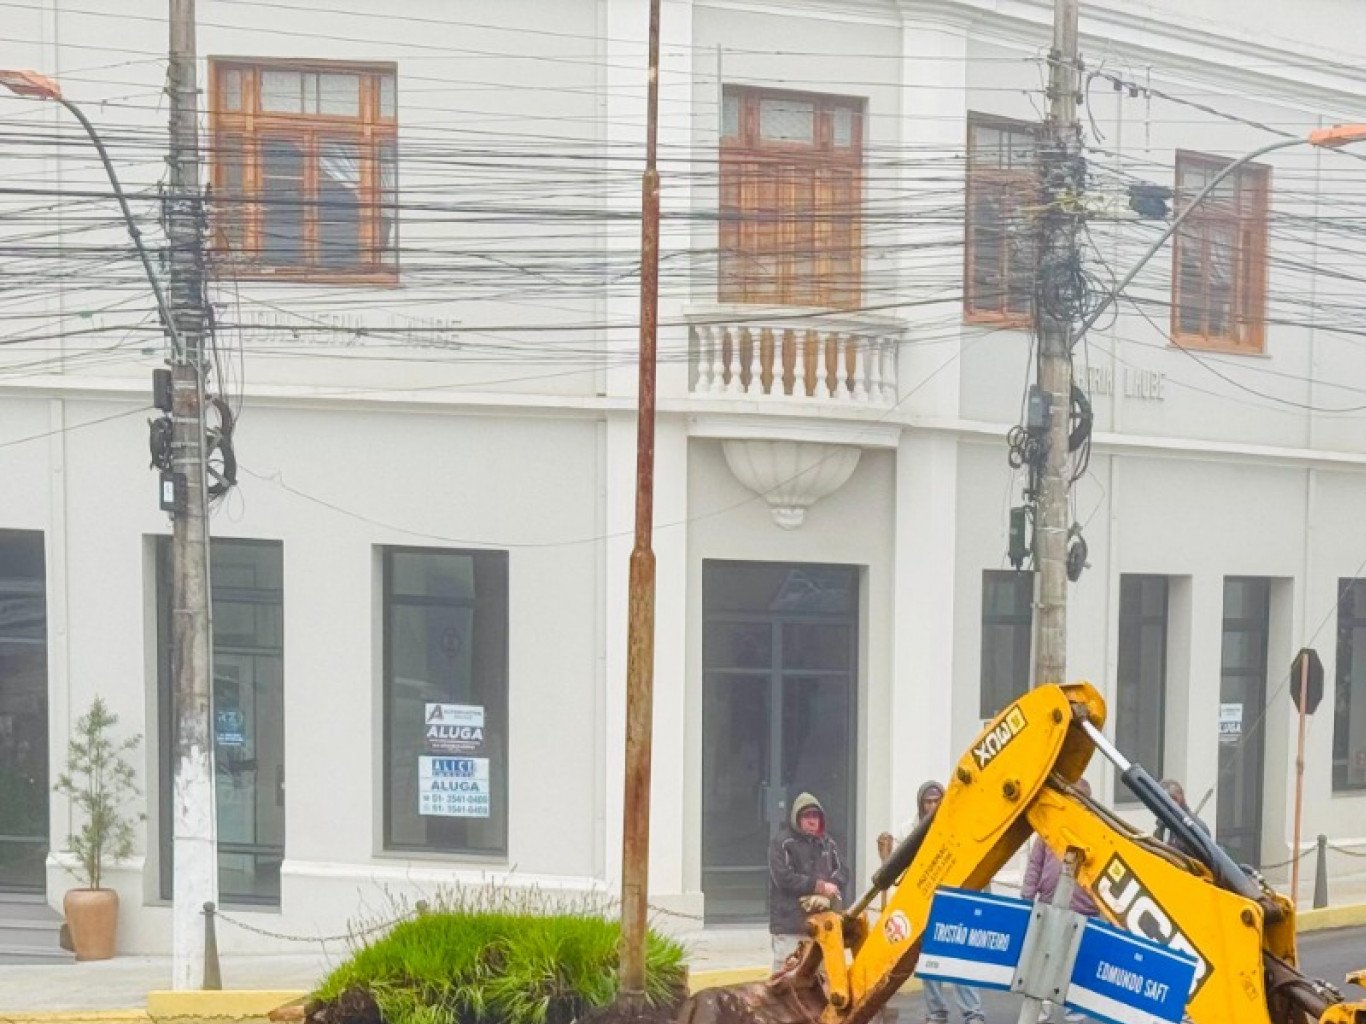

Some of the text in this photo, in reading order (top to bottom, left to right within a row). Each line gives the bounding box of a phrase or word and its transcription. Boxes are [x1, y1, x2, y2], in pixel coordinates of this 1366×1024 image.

[426, 725, 484, 740] ALUGA
[431, 781, 480, 792] ALUGA
[933, 921, 968, 945] TRISTÃO
[1096, 960, 1170, 1003] EDMUNDO SAFT
